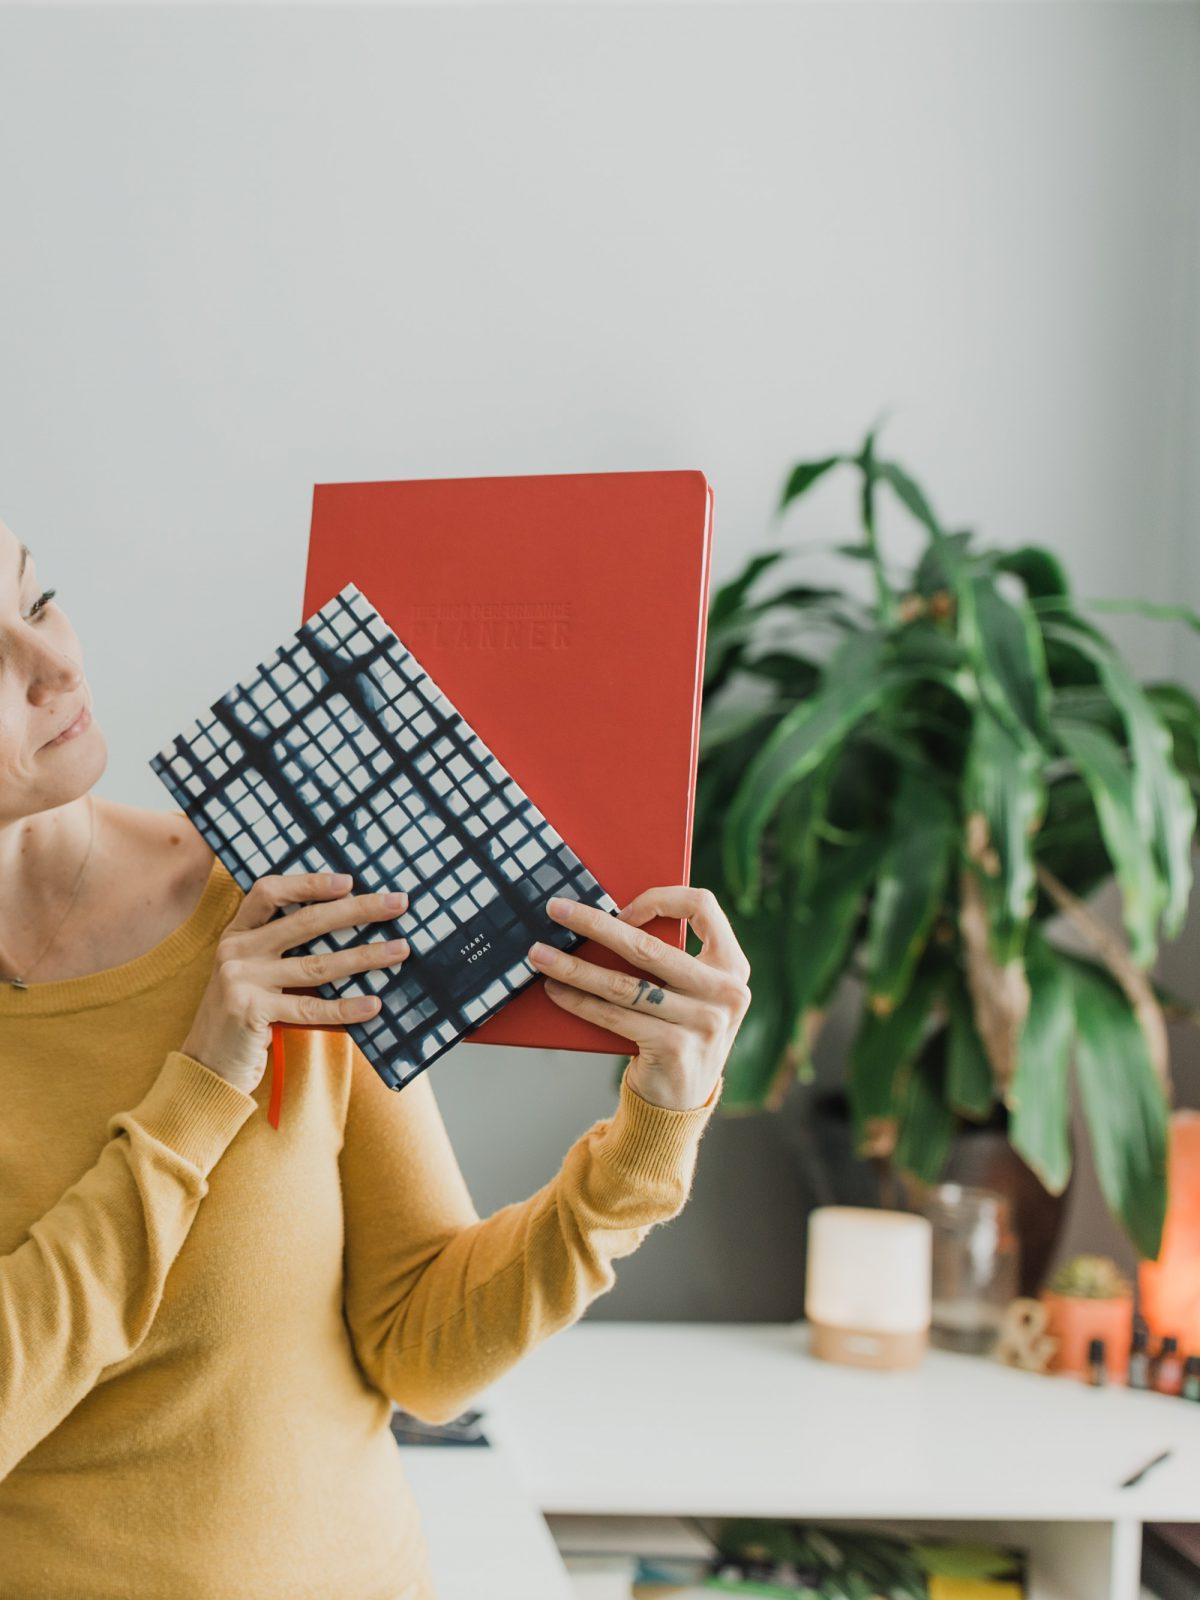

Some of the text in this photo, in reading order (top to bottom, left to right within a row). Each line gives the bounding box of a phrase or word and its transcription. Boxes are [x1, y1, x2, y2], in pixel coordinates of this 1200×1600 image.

[409, 621, 571, 650] PLANNER
[461, 934, 485, 956] START
[467, 942, 491, 963] TODAY
